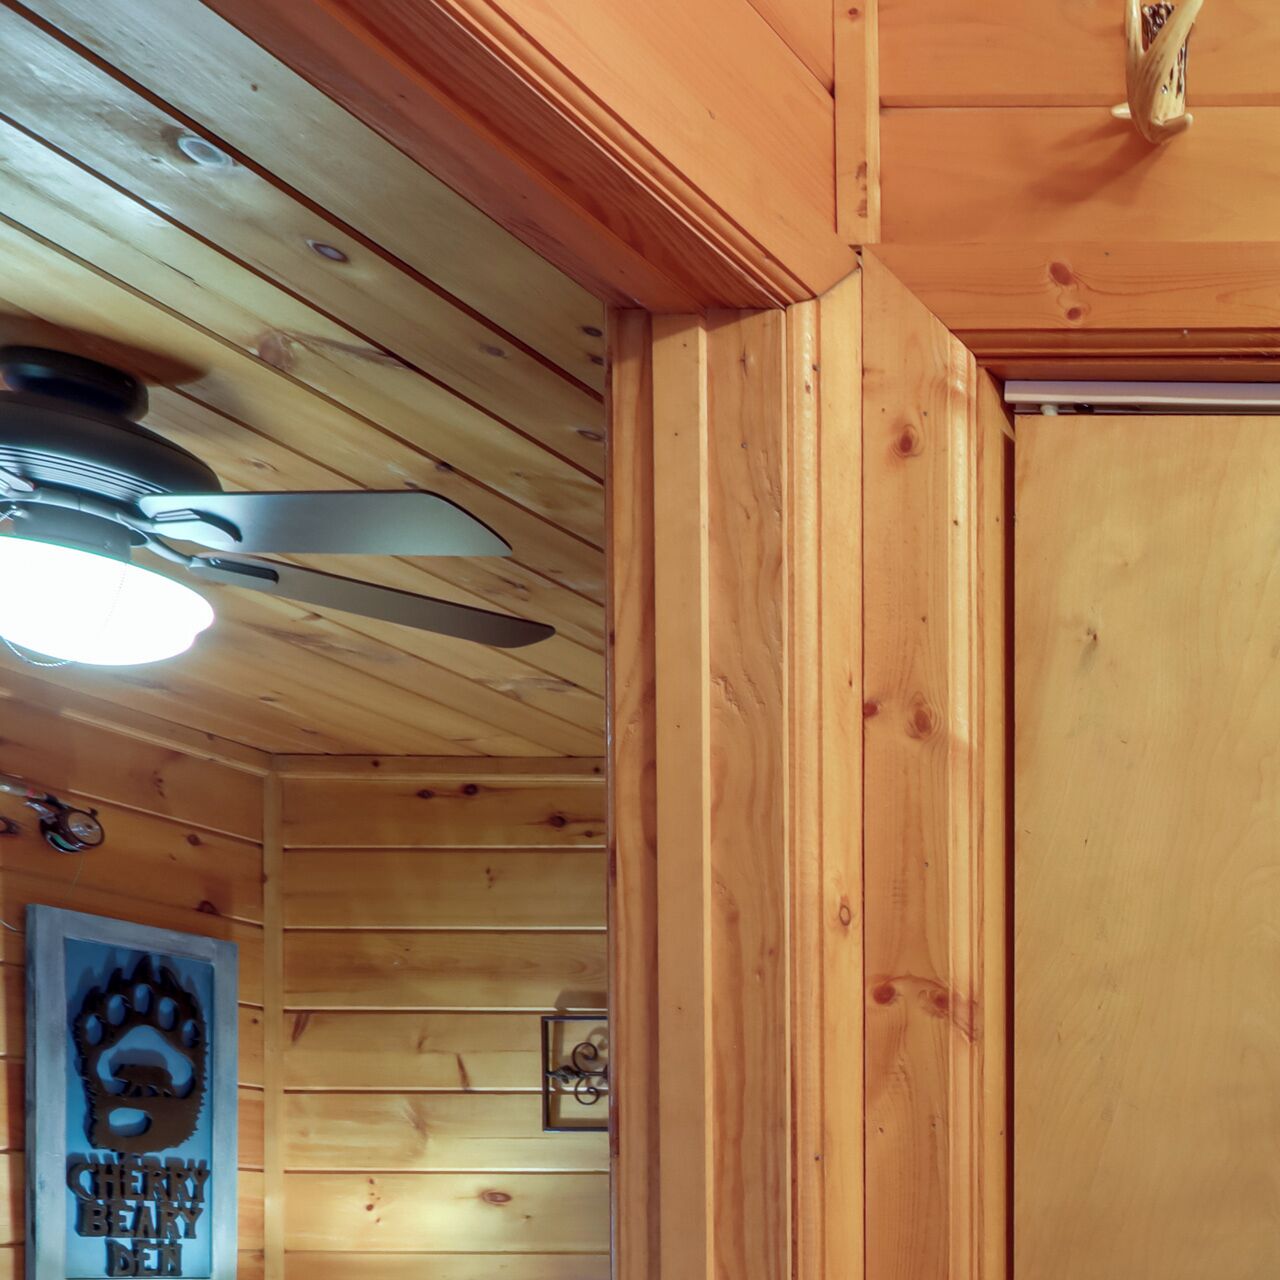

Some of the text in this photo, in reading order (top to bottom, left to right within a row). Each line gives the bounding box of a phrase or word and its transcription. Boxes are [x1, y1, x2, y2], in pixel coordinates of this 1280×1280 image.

[67, 1160, 211, 1203] CHERRY
[78, 1205, 204, 1240] BEARY
[107, 1241, 182, 1277] DEN
